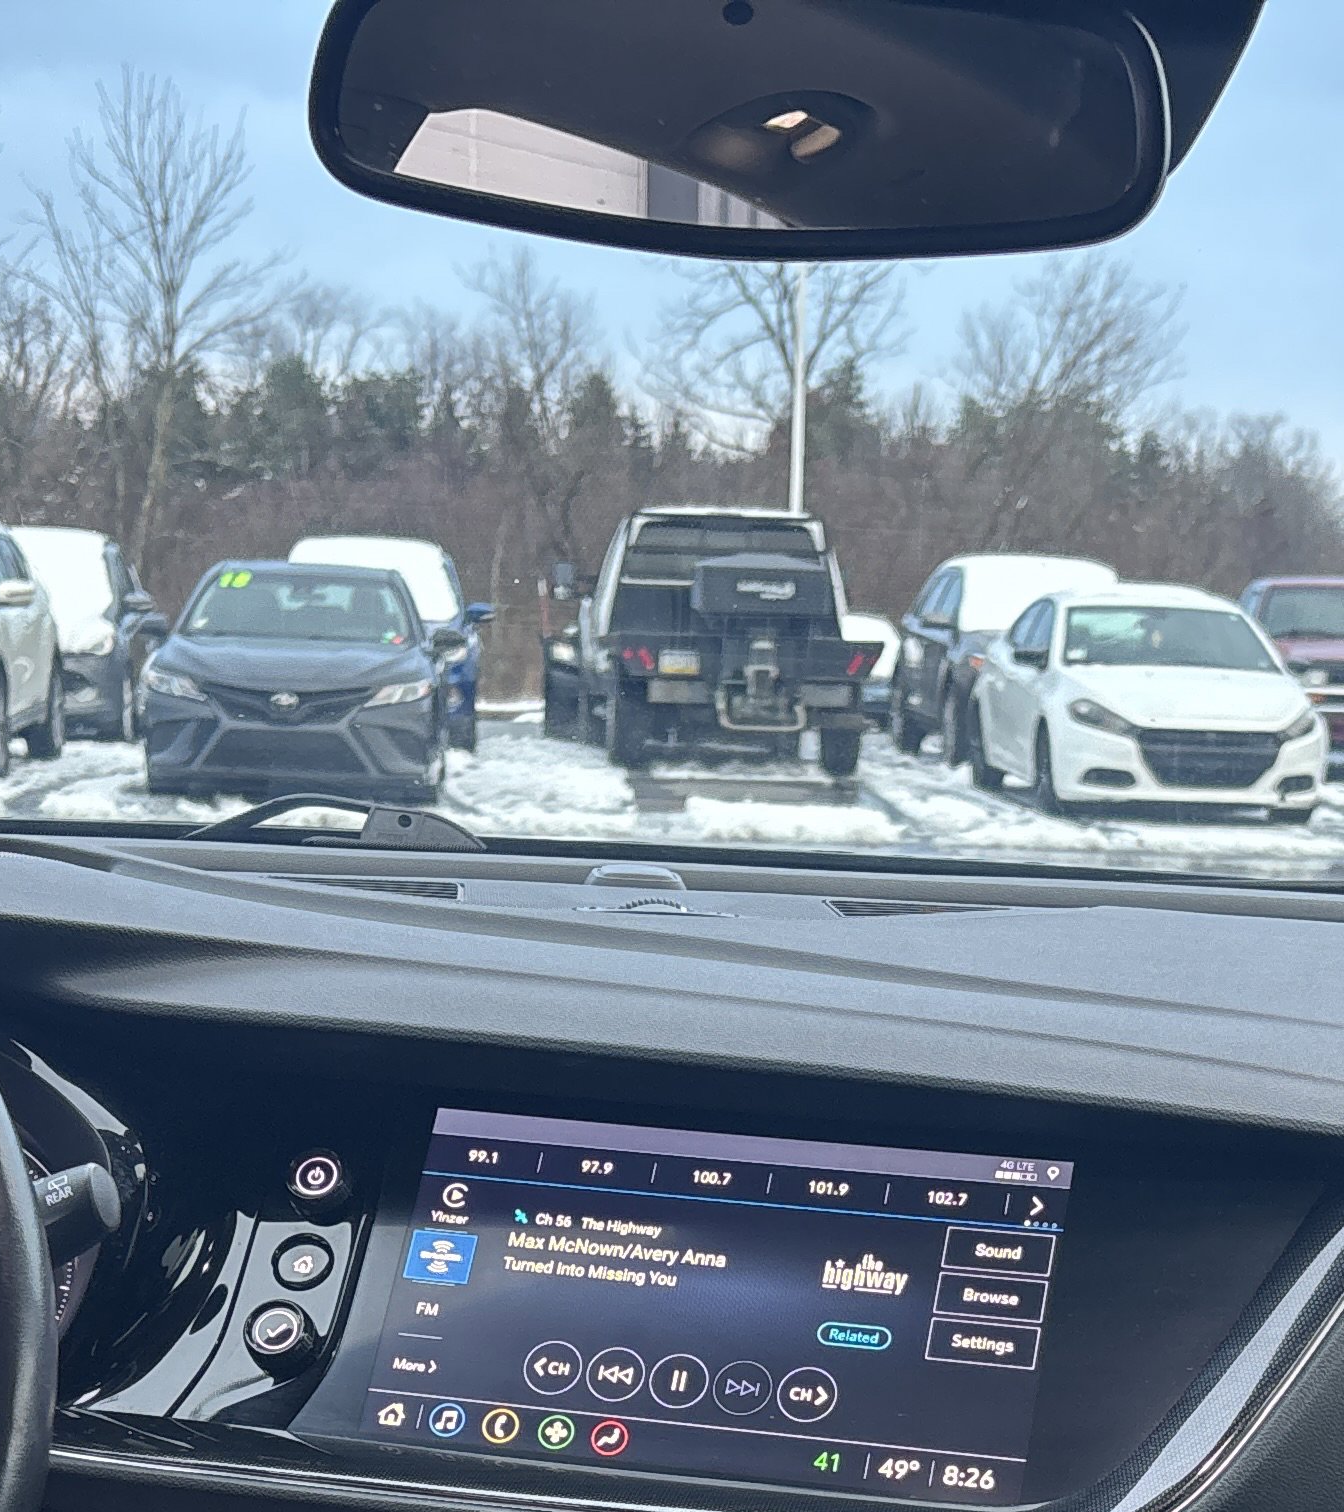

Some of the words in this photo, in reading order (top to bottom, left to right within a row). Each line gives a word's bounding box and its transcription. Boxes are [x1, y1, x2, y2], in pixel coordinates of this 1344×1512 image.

[468, 1149, 499, 1165] 99.1
[999, 1159, 1016, 1171] 4G
[1016, 1161, 1035, 1172] LTE
[580, 1160, 614, 1175] 97.9
[692, 1169, 732, 1186] 100.7
[45, 1185, 74, 1207] REAR
[808, 1180, 850, 1197] 101.9
[926, 1190, 969, 1207] 102.7
[534, 1213, 554, 1227] Ch
[555, 1214, 572, 1228] 56
[581, 1217, 606, 1232] The
[607, 1219, 663, 1239] Highway
[508, 1231, 544, 1251] Max
[548, 1235, 680, 1266] McNown/Avery
[680, 1248, 727, 1268] Anna
[974, 1243, 1023, 1261] Sound
[503, 1256, 554, 1275] Turned
[556, 1262, 586, 1278] Into
[587, 1265, 646, 1287] Missing
[649, 1271, 678, 1287] You
[861, 1253, 884, 1272] the
[821, 1260, 909, 1295] highway
[962, 1288, 1019, 1306] Browse
[415, 1301, 440, 1317] FM
[828, 1328, 880, 1346] Related
[951, 1333, 1015, 1357] Settings
[392, 1357, 426, 1373] More
[547, 1360, 570, 1377] CH
[788, 1386, 812, 1402] CH
[813, 1451, 841, 1473] 41
[942, 1464, 996, 1490] 8:26
